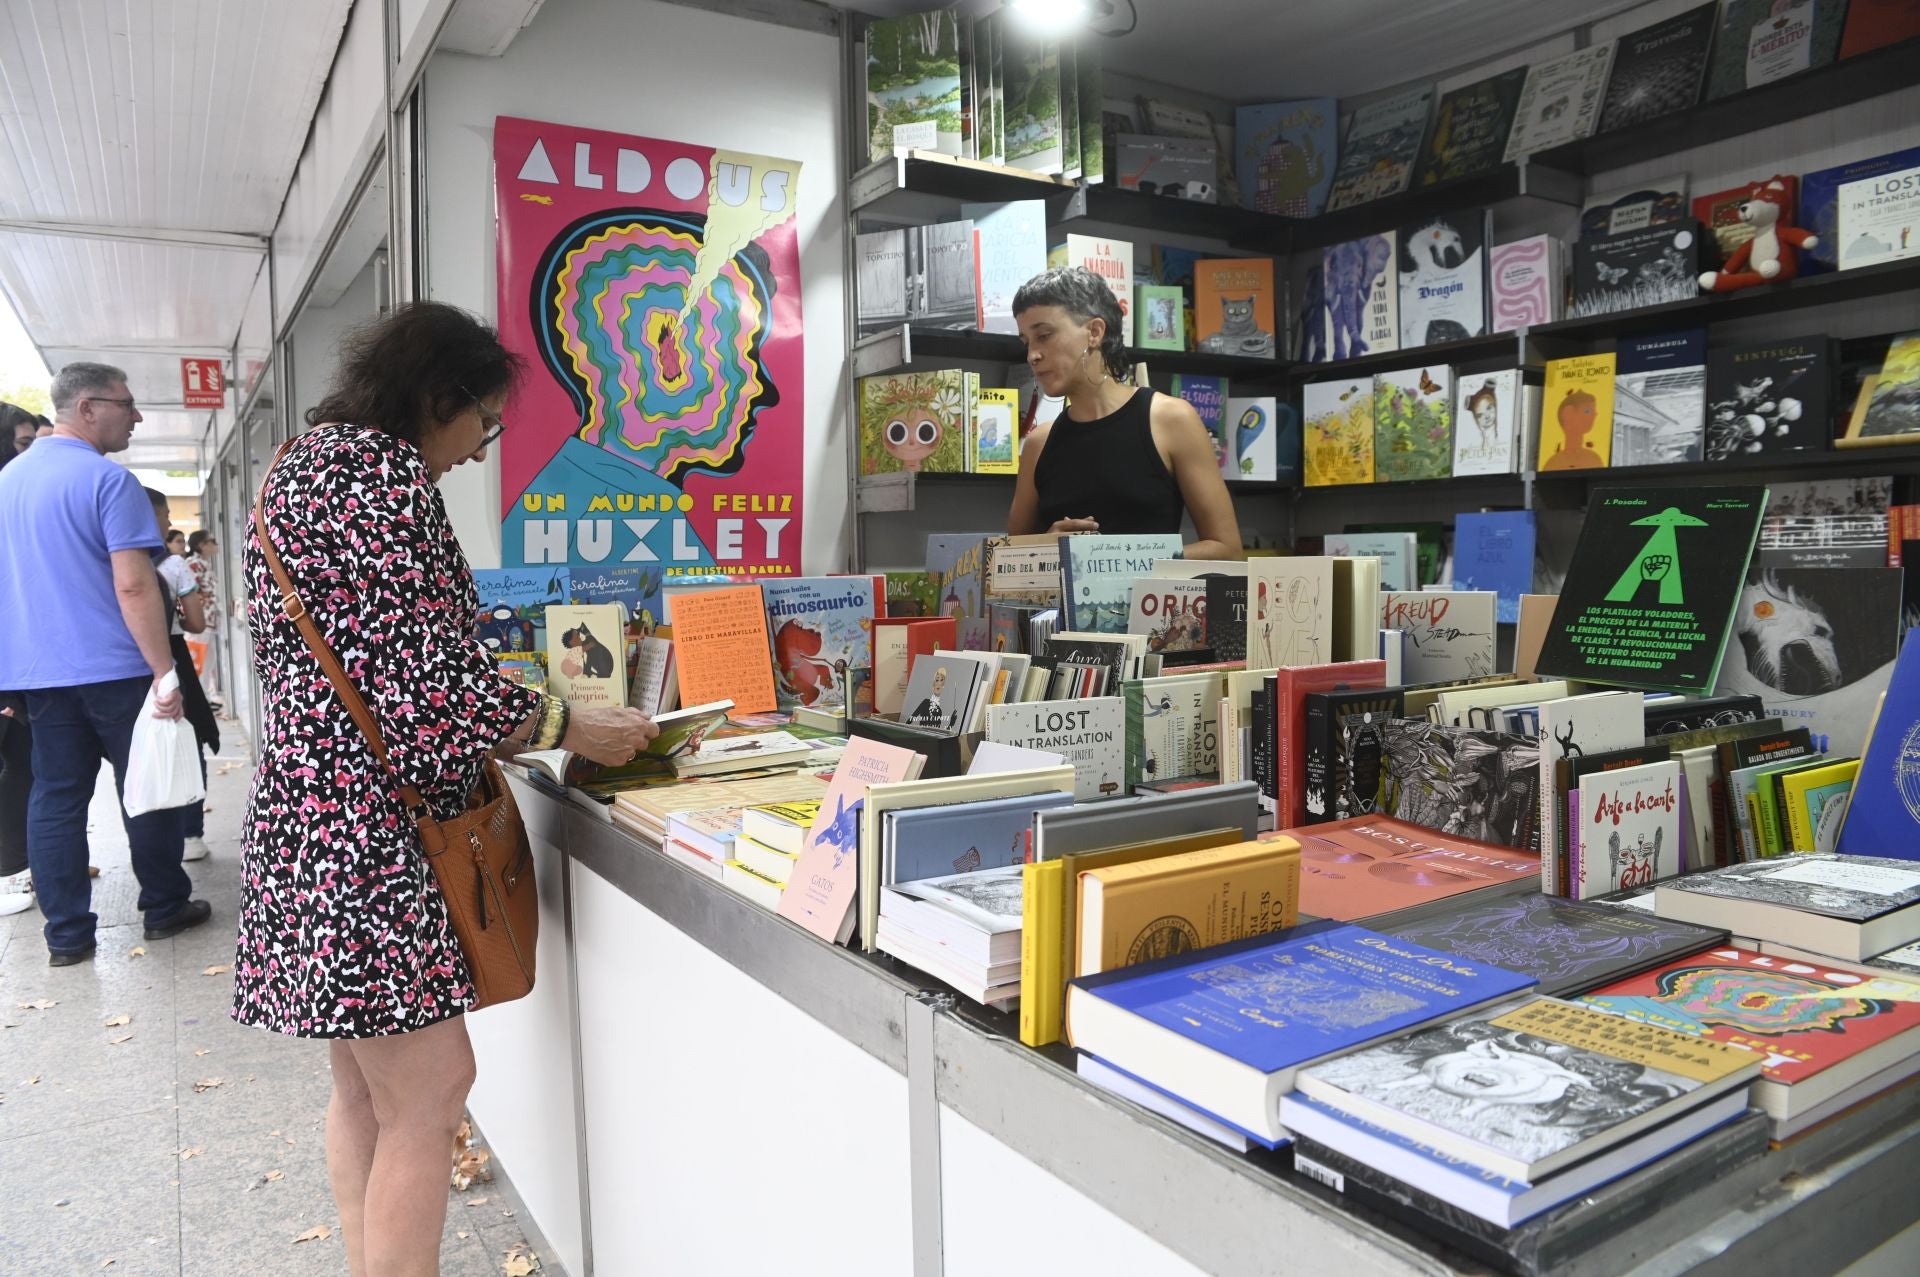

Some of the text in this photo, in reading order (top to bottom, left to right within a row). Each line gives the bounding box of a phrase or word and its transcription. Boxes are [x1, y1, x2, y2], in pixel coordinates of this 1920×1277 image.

[516, 136, 790, 212] ALDOUS
[983, 229, 1037, 248] ARICIA
[1096, 243, 1111, 256] LA
[1417, 282, 1463, 299] Dragón
[1373, 302, 1388, 315] VIDA
[1370, 329, 1392, 341] LARGA
[523, 493, 793, 513] UN MUNDO FELIZ
[1613, 498, 1648, 506] Posadas
[522, 518, 792, 564] HUXLEY
[666, 564, 793, 577] DE CRISTINA DAURA
[1087, 558, 1122, 574] SIETE
[570, 576, 629, 592] Serafina
[769, 585, 811, 596] Nunca bailes
[770, 592, 865, 617] dinosaurio
[1382, 593, 1450, 627] FREUD
[1602, 608, 1643, 616] PLATILLOS
[1644, 609, 1696, 620] VOLADORES,
[1589, 617, 1624, 626] PROCESO
[1652, 620, 1690, 630] MATERIA
[1693, 622, 1700, 630] Y
[681, 627, 762, 643] LIBRO DE MARAVILLAS
[1577, 625, 1613, 636] ENERGÍA,
[1615, 628, 1627, 636] LA
[1628, 629, 1662, 639] CIENCIA,
[1665, 631, 1676, 639] LA
[1678, 632, 1706, 641] LUCHA
[1571, 635, 1692, 650] DE CLASES Y REVOLUCIONARIA
[1586, 646, 1597, 654] EL
[1598, 647, 1629, 656] FUTURO
[1631, 649, 1677, 660] SOCIALISTA
[1586, 656, 1662, 669] DE LA HUMANIDAD
[1035, 711, 1090, 734] LOST
[1027, 730, 1113, 750] TRANSLATION
[1193, 693, 1202, 775] IN TRANSLA
[858, 755, 889, 773] PATRICIA
[848, 766, 890, 784] HIGHSMITH
[1594, 789, 1624, 826] Arte
[1625, 802, 1633, 812] a
[1635, 791, 1645, 814] la
[811, 874, 834, 893] GATOS
[1354, 936, 1421, 958] Daniel
[1505, 1019, 1571, 1039] ENRIQUE
[1545, 1003, 1729, 1052] GEORGE ORWELL
[1628, 1009, 1715, 1034] MUNDO
[1729, 1035, 1814, 1060] FELIZ
